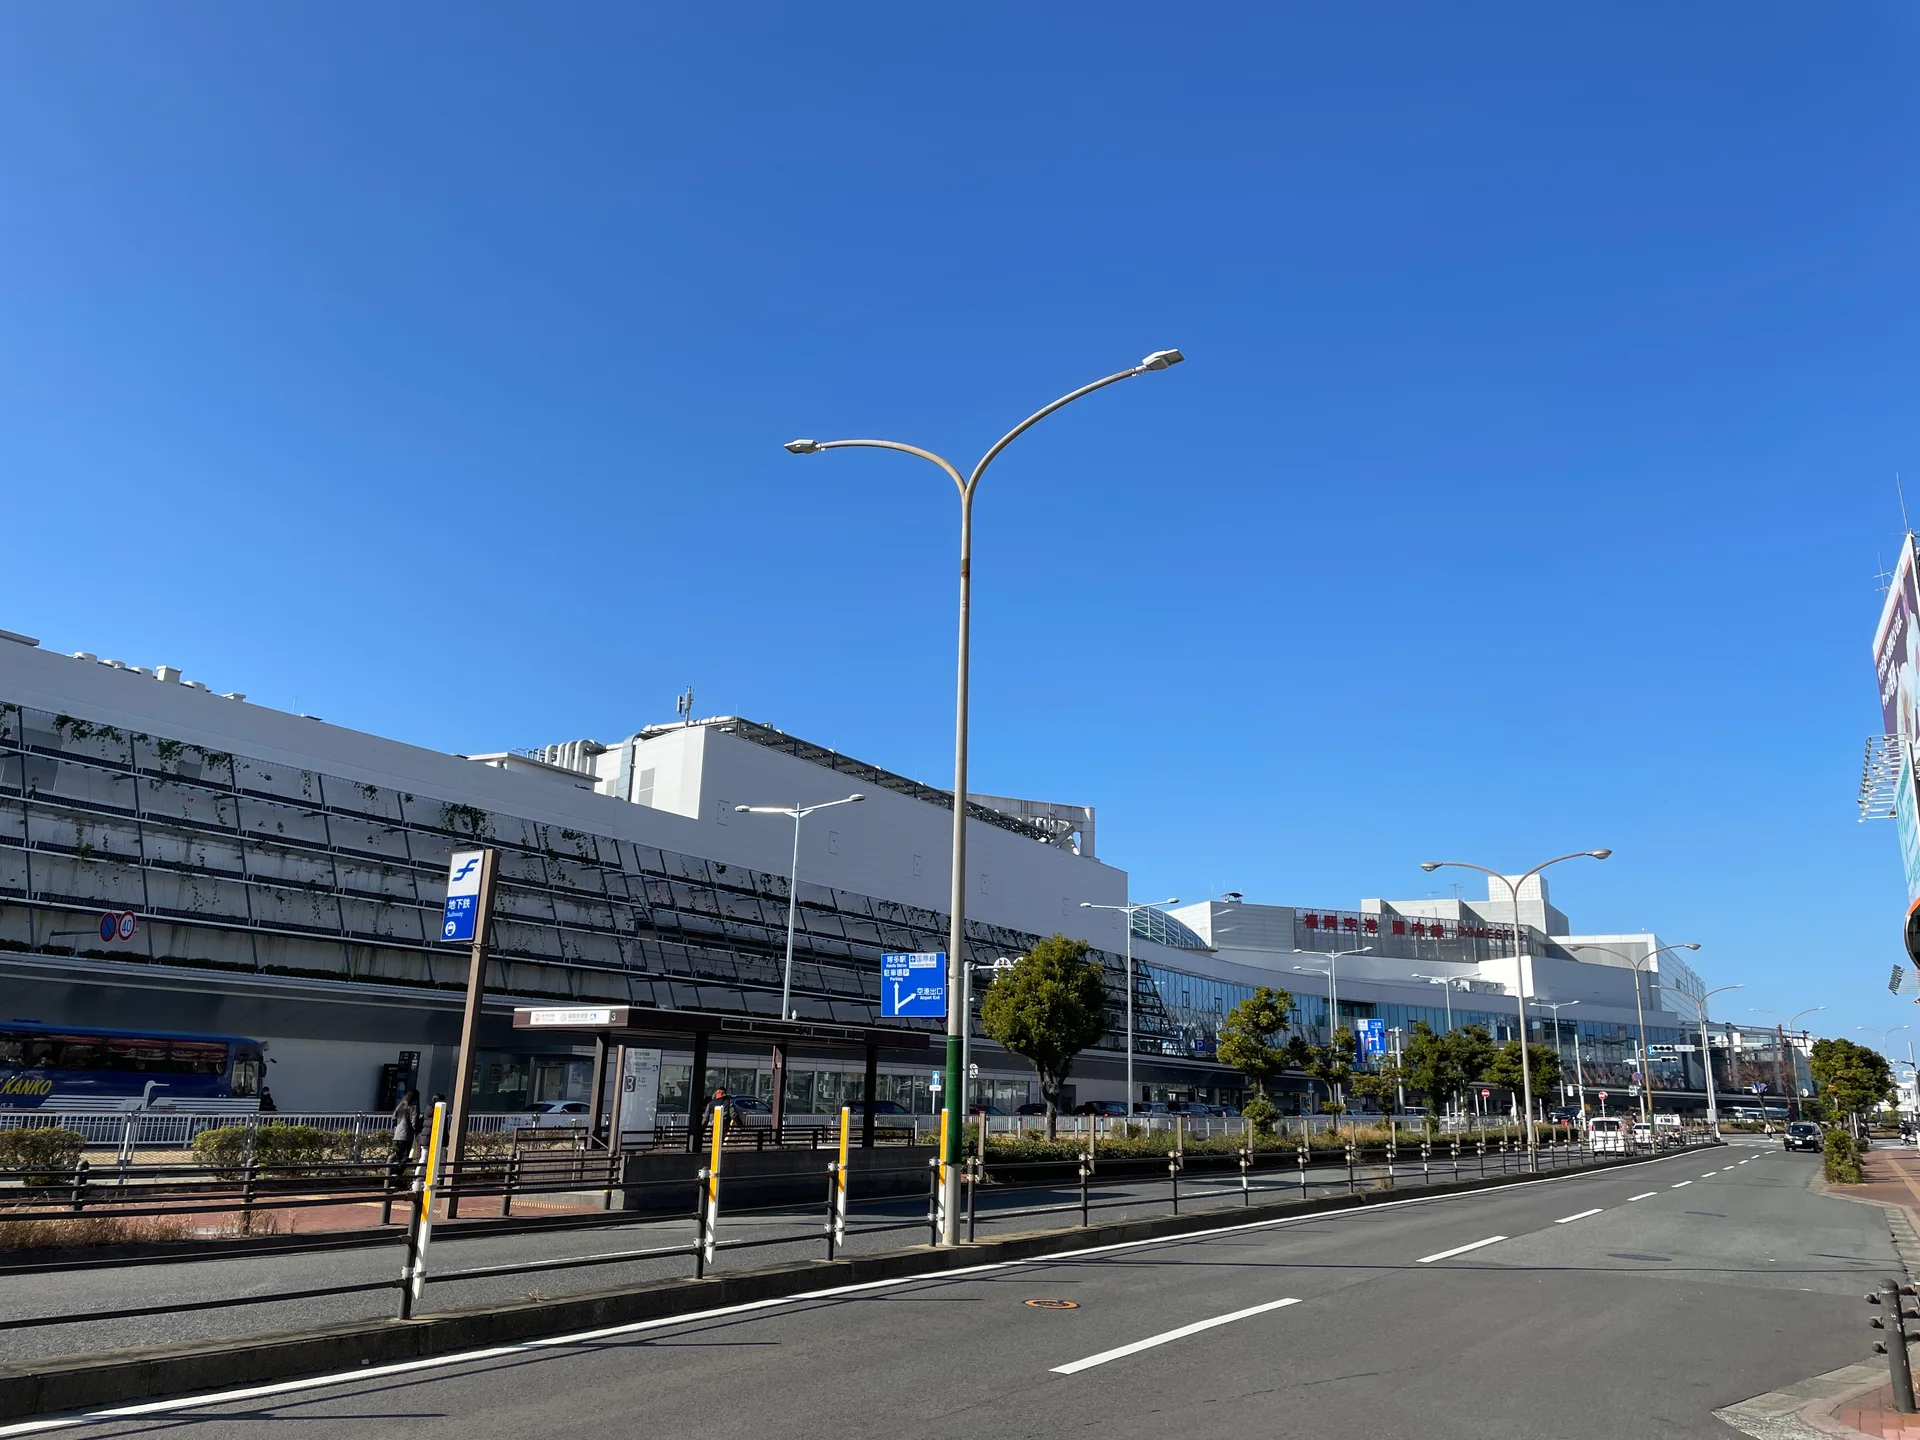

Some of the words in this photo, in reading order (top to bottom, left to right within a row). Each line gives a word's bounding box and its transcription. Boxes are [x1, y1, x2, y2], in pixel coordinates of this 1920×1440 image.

[448, 898, 471, 910] 地下鉄
[121, 919, 132, 933] 40
[1457, 925, 1524, 941] DOMESTIC
[916, 987, 943, 996] 空港出口
[611, 1012, 616, 1021] 3
[1197, 1041, 1204, 1050] P
[0, 1078, 53, 1095] KANKO
[626, 1076, 634, 1092] 3
